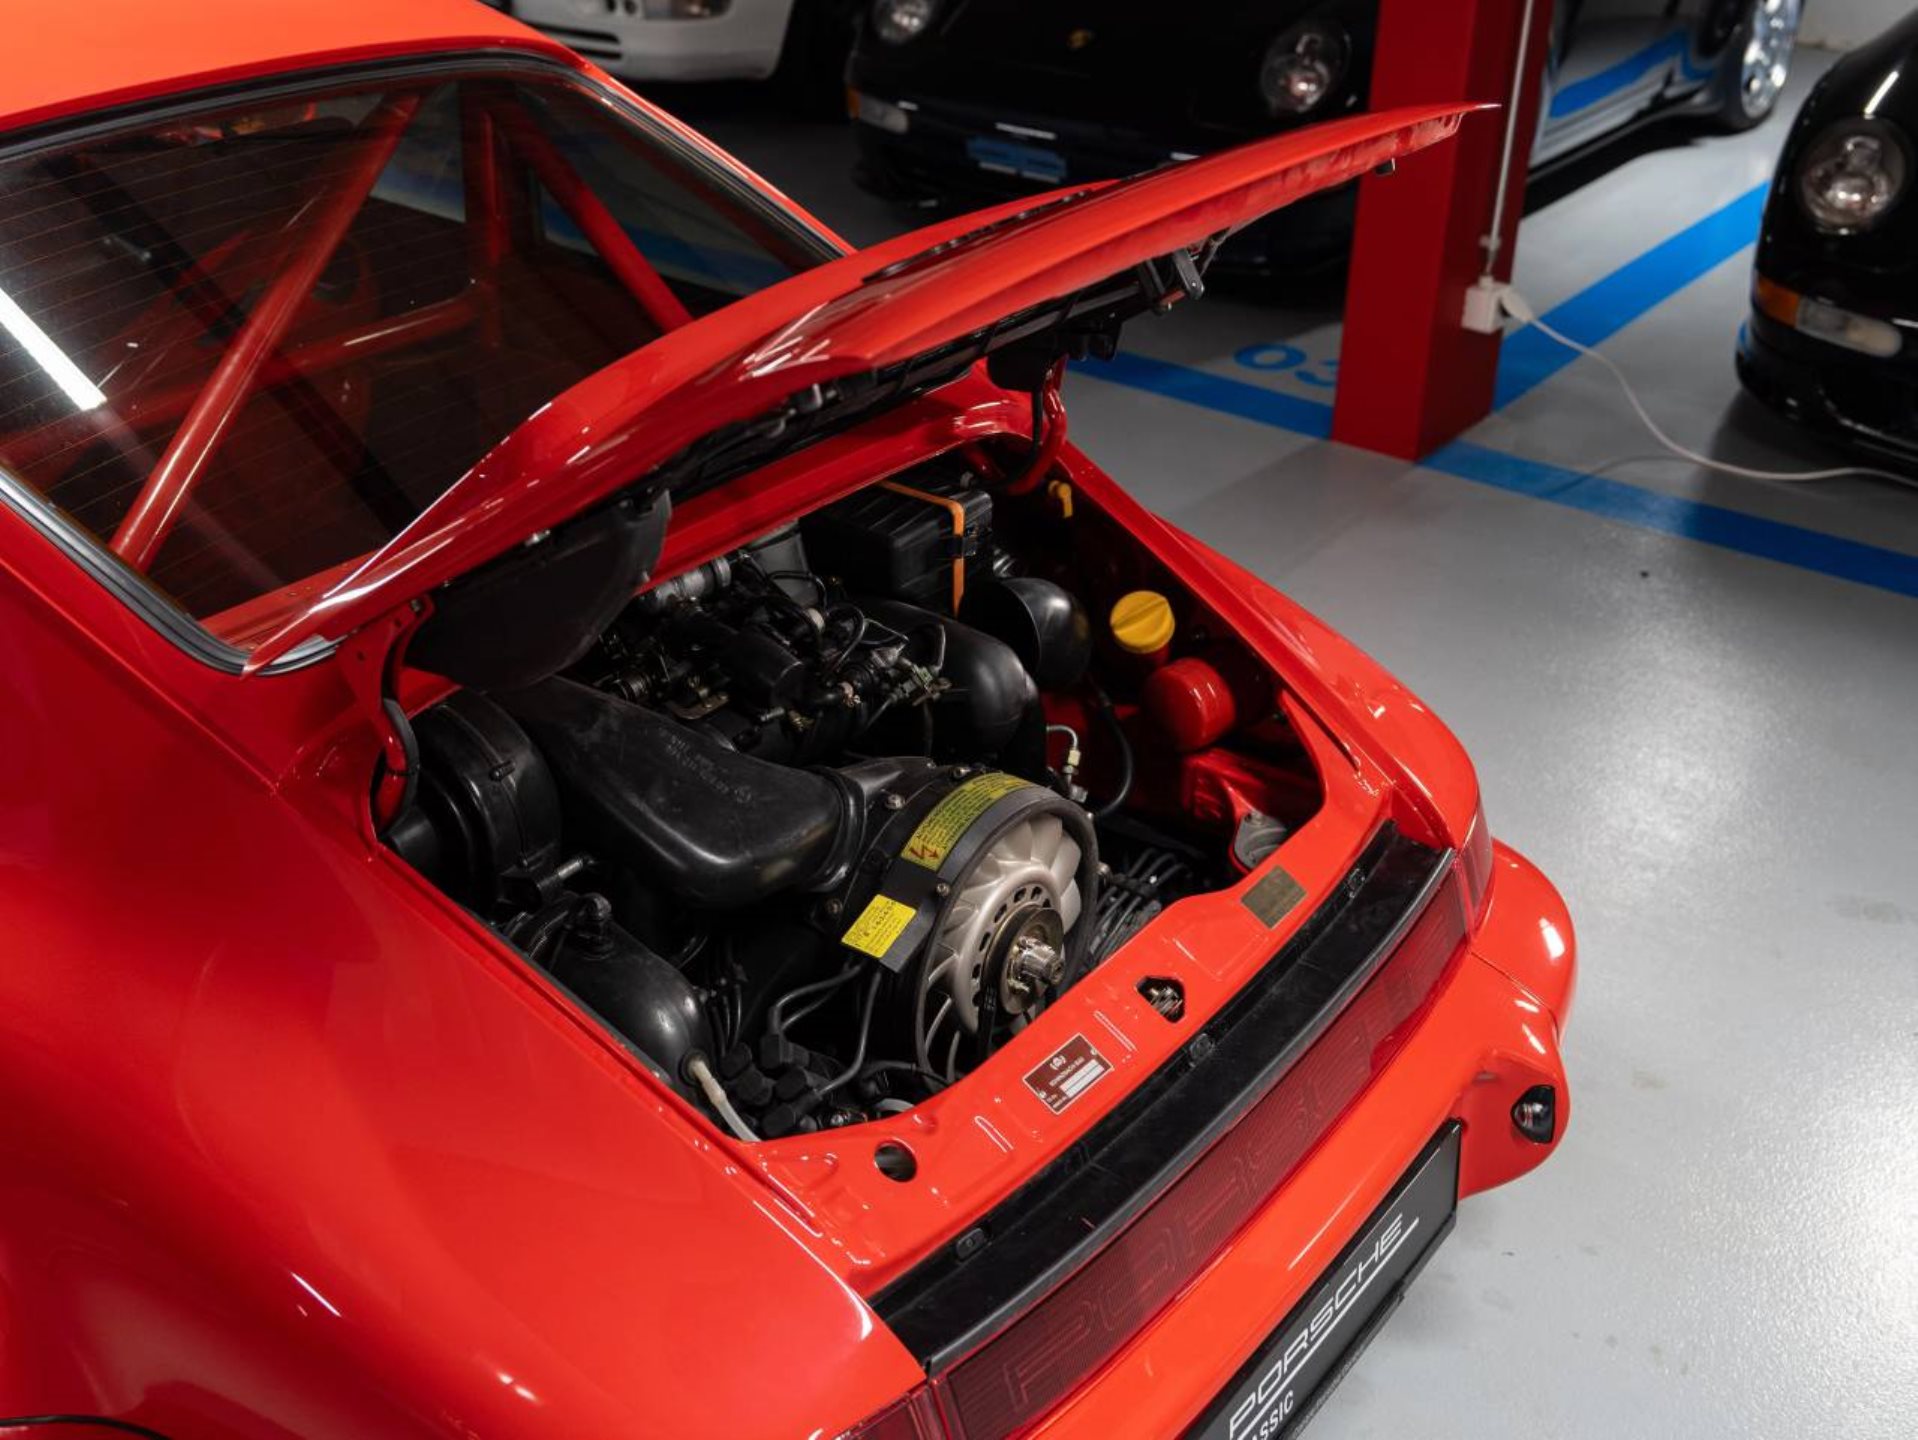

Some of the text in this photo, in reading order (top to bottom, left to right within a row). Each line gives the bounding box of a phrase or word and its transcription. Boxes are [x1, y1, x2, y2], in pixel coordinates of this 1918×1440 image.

[1003, 915, 1443, 1414] PORSC
[1229, 1213, 1403, 1440] PORSCHE
[1251, 1390, 1295, 1440] SSIC
